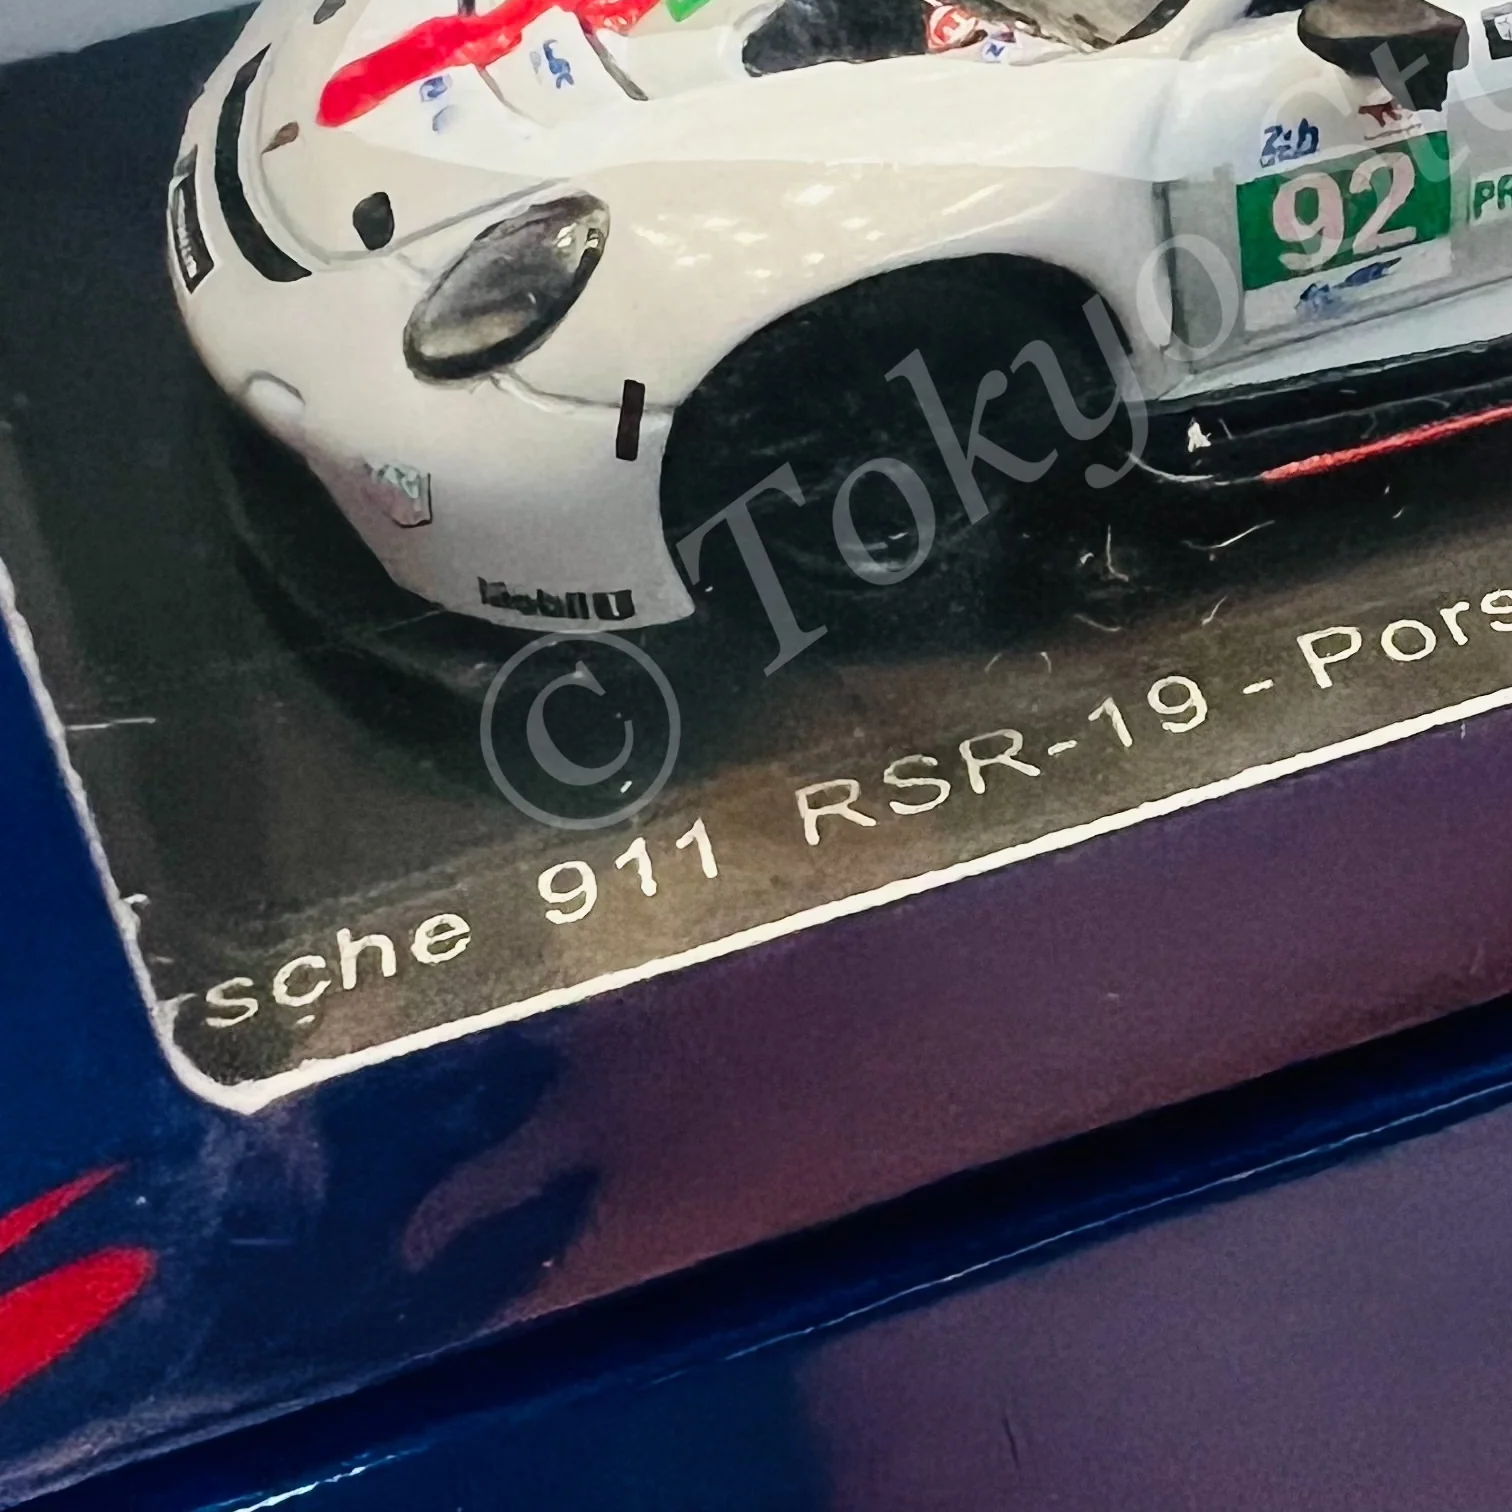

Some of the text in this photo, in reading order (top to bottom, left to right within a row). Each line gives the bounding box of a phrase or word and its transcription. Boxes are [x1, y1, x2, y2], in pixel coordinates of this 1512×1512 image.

[1272, 151, 1417, 272] 92
[537, 817, 718, 924] 911
[795, 674, 1209, 846] RSR-19
